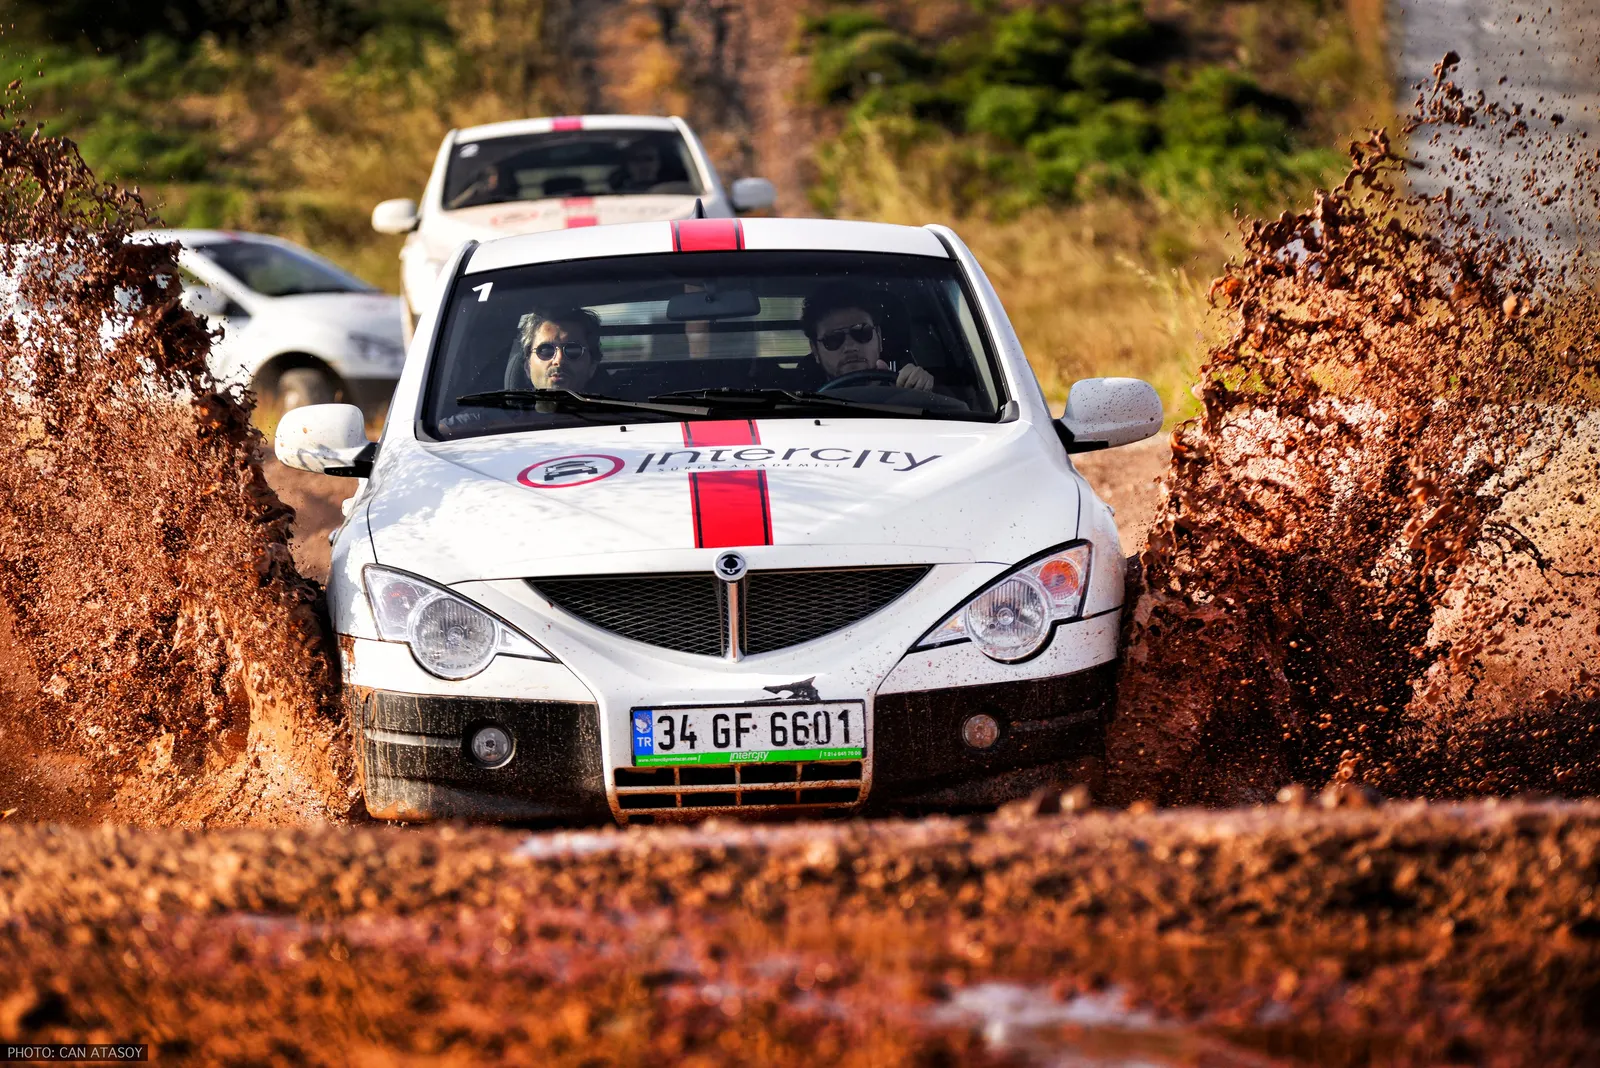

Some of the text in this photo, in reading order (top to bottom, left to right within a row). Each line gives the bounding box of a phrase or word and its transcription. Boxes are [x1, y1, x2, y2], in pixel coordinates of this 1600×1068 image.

[471, 281, 494, 302] 1
[636, 709, 850, 751] TR 34 GF 6601
